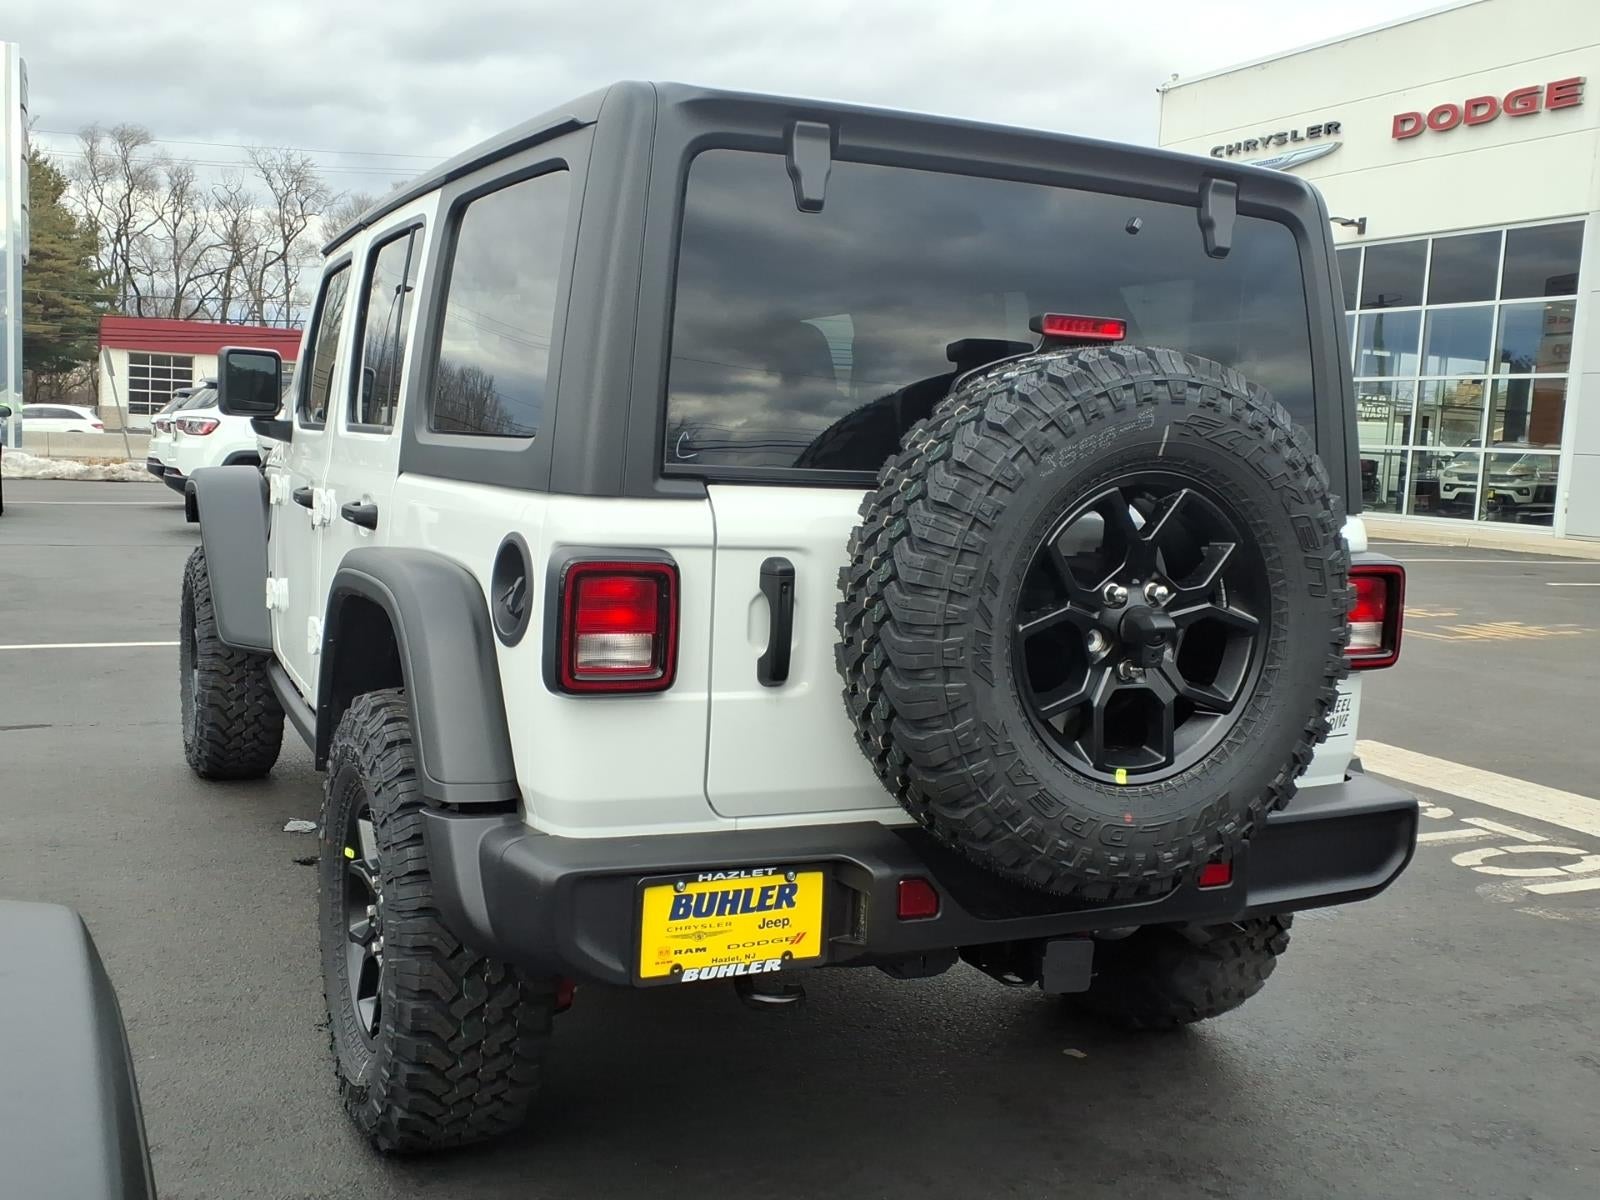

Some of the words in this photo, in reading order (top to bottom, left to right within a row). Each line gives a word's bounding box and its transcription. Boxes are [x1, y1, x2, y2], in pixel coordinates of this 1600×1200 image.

[1391, 76, 1587, 140] DODGE
[1210, 121, 1342, 158] CHRYSLER
[1329, 713, 1350, 731] RIVE
[697, 867, 778, 882] HAZLET
[668, 883, 798, 922] BUHLER
[666, 921, 733, 933] CHRYSLER
[758, 917, 790, 930] Jeep
[727, 934, 799, 950] DODGE
[673, 946, 708, 956] RAM
[744, 953, 757, 961] NJ
[681, 959, 782, 983] BUHLER
